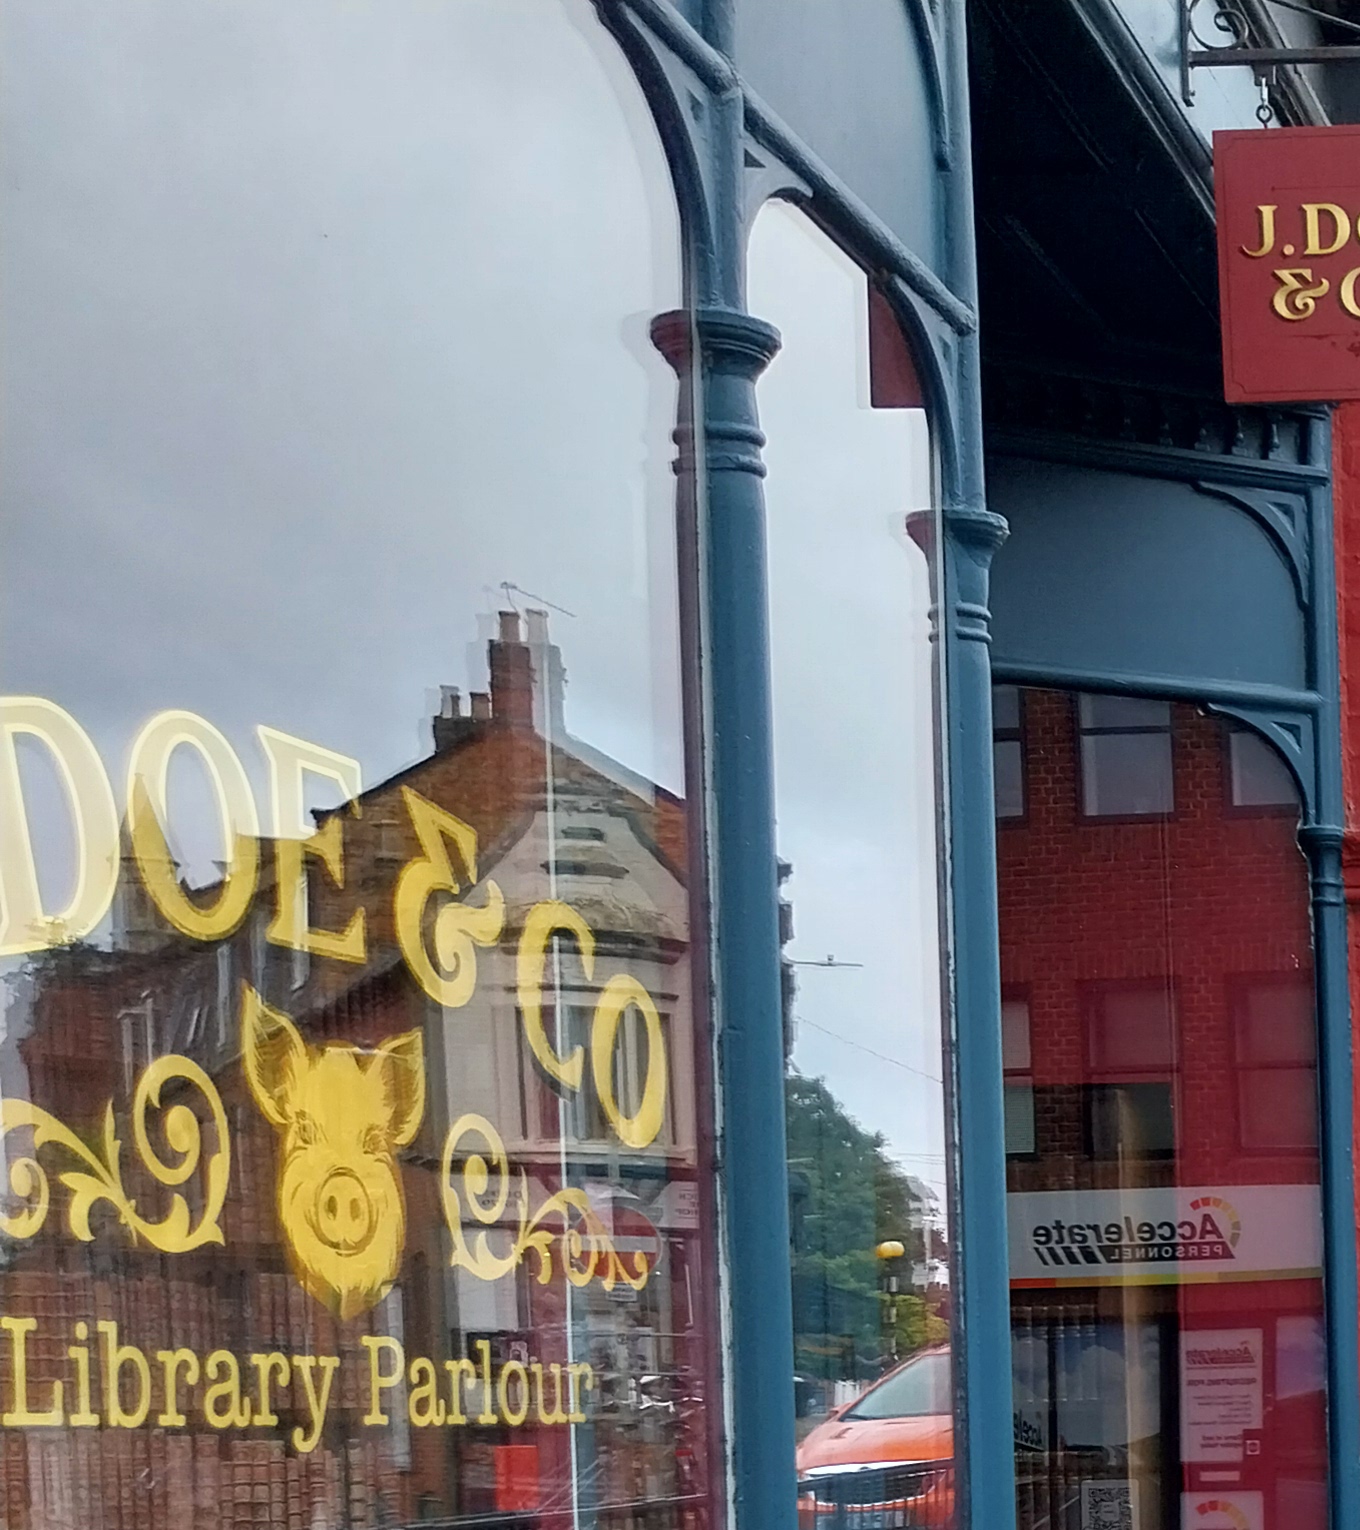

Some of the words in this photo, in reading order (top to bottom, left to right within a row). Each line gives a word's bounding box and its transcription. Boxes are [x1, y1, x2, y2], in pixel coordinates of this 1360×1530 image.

[397, 784, 506, 1008] &
[516, 899, 668, 1149] CO
[0, 1316, 340, 1453] Library
[360, 1335, 596, 1428] Parlour
